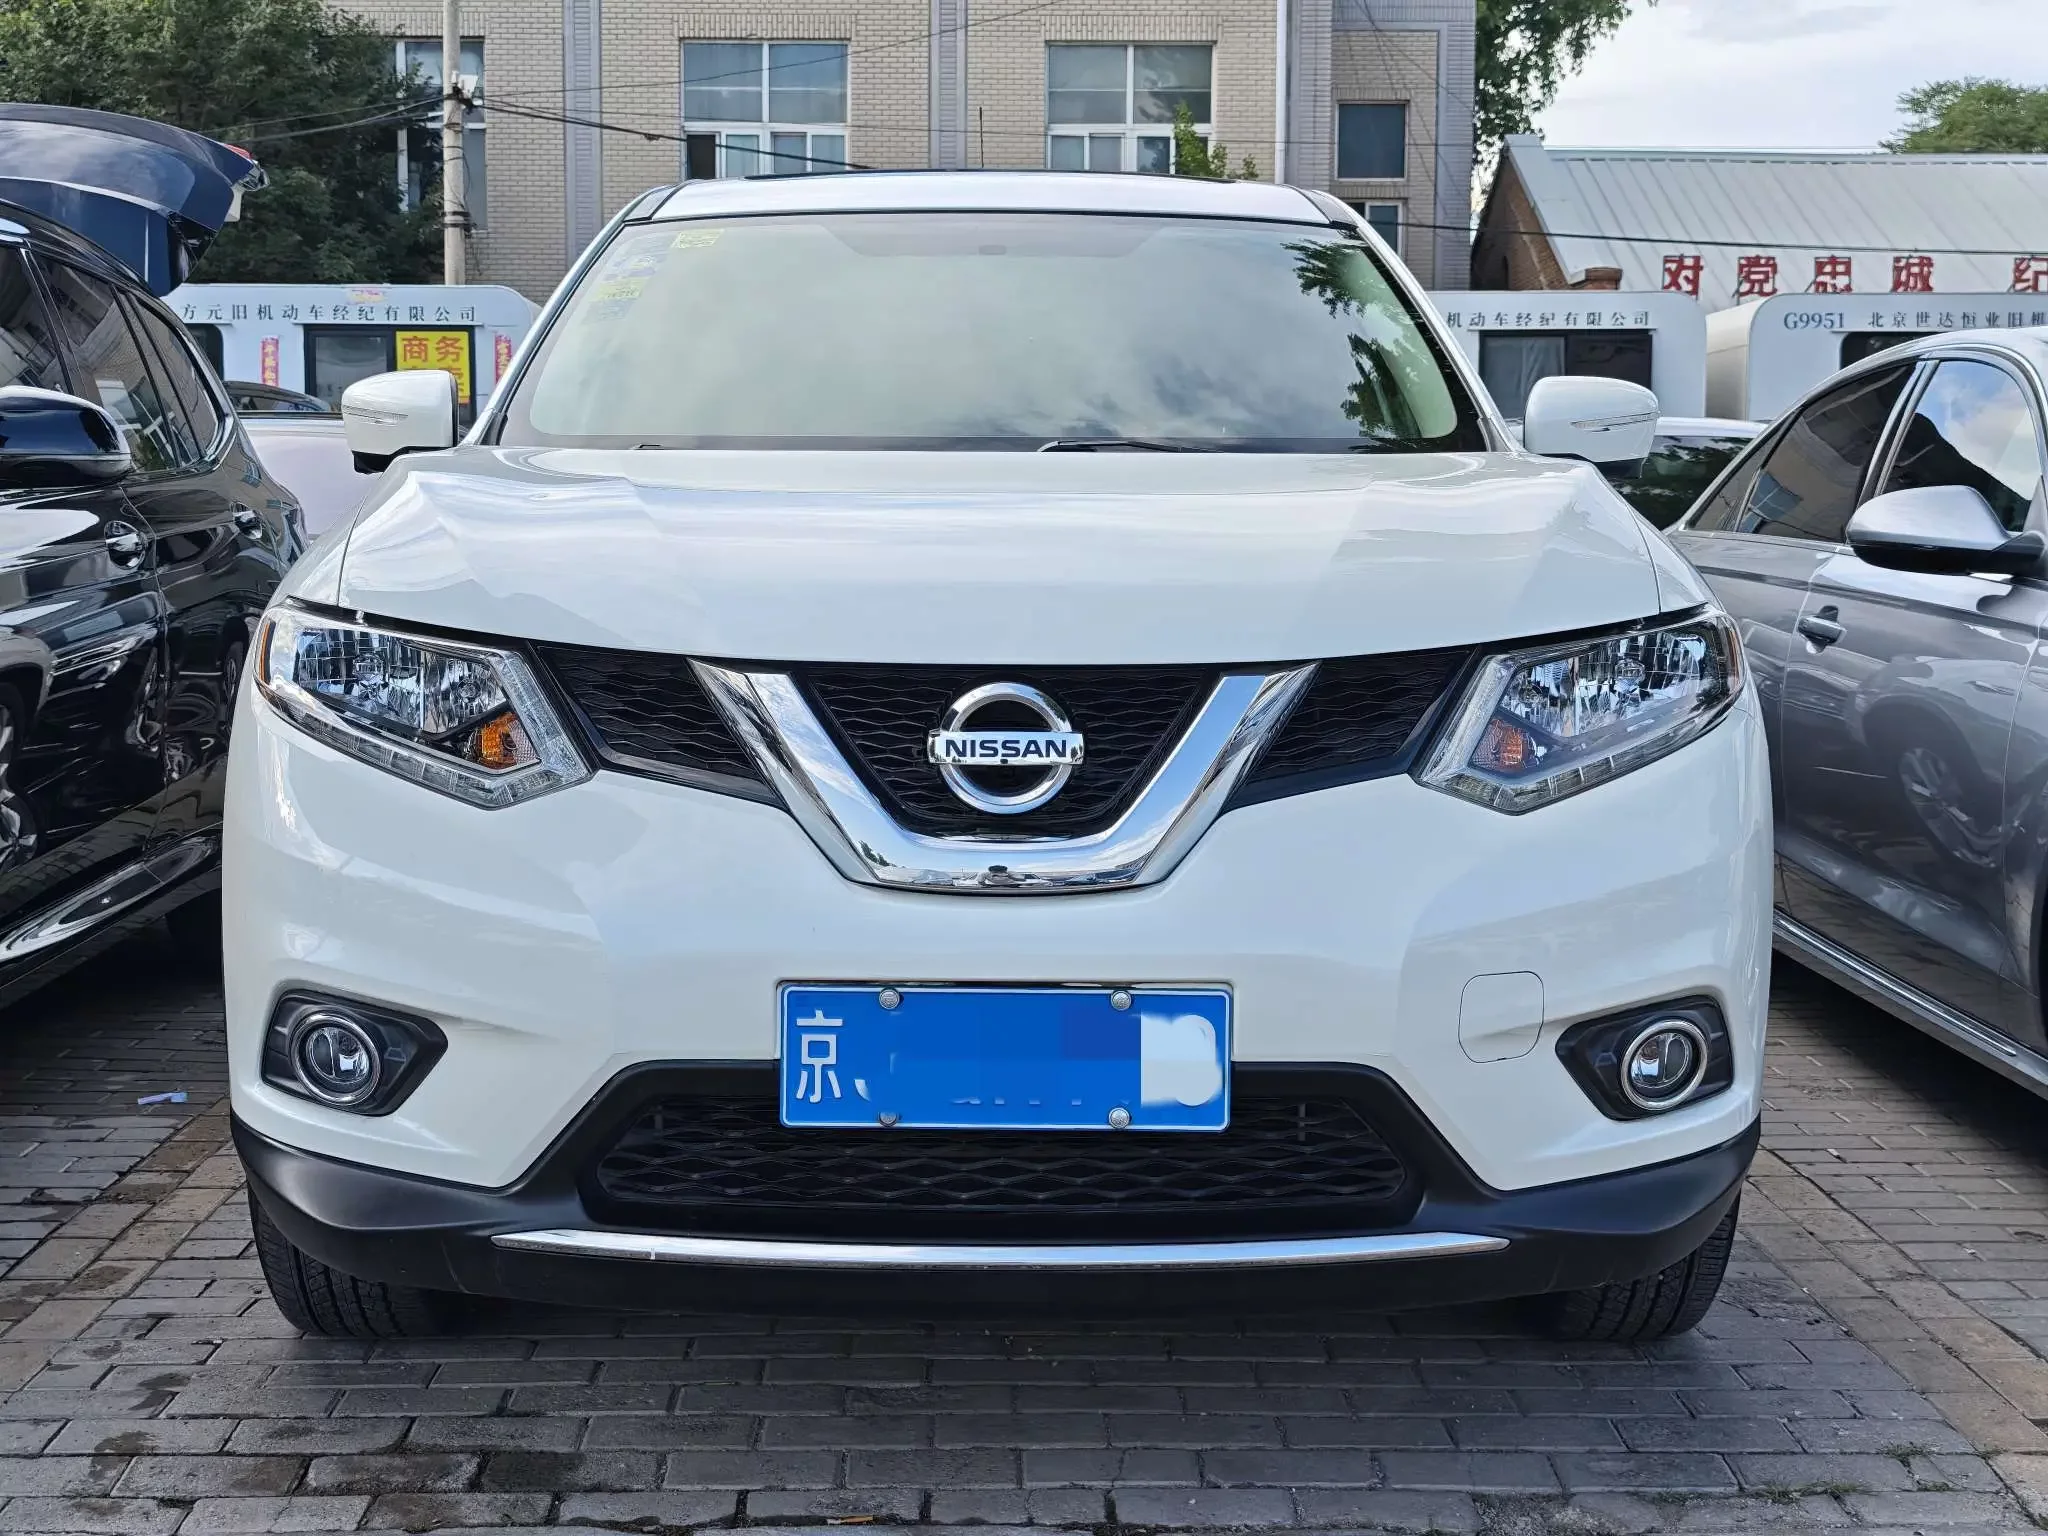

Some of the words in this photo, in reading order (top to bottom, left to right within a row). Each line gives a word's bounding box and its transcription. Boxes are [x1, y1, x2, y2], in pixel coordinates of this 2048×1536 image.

[1662, 255, 1934, 297] 对党忠诚
[181, 303, 477, 322] 方元旧机动车经纪有限公司
[1446, 310, 1650, 329] 机动车经纪有限公司
[1784, 312, 1845, 330] G9951
[401, 336, 464, 362] 商务
[945, 739, 1067, 758] NISSAN
[796, 1009, 843, 1103] 京
